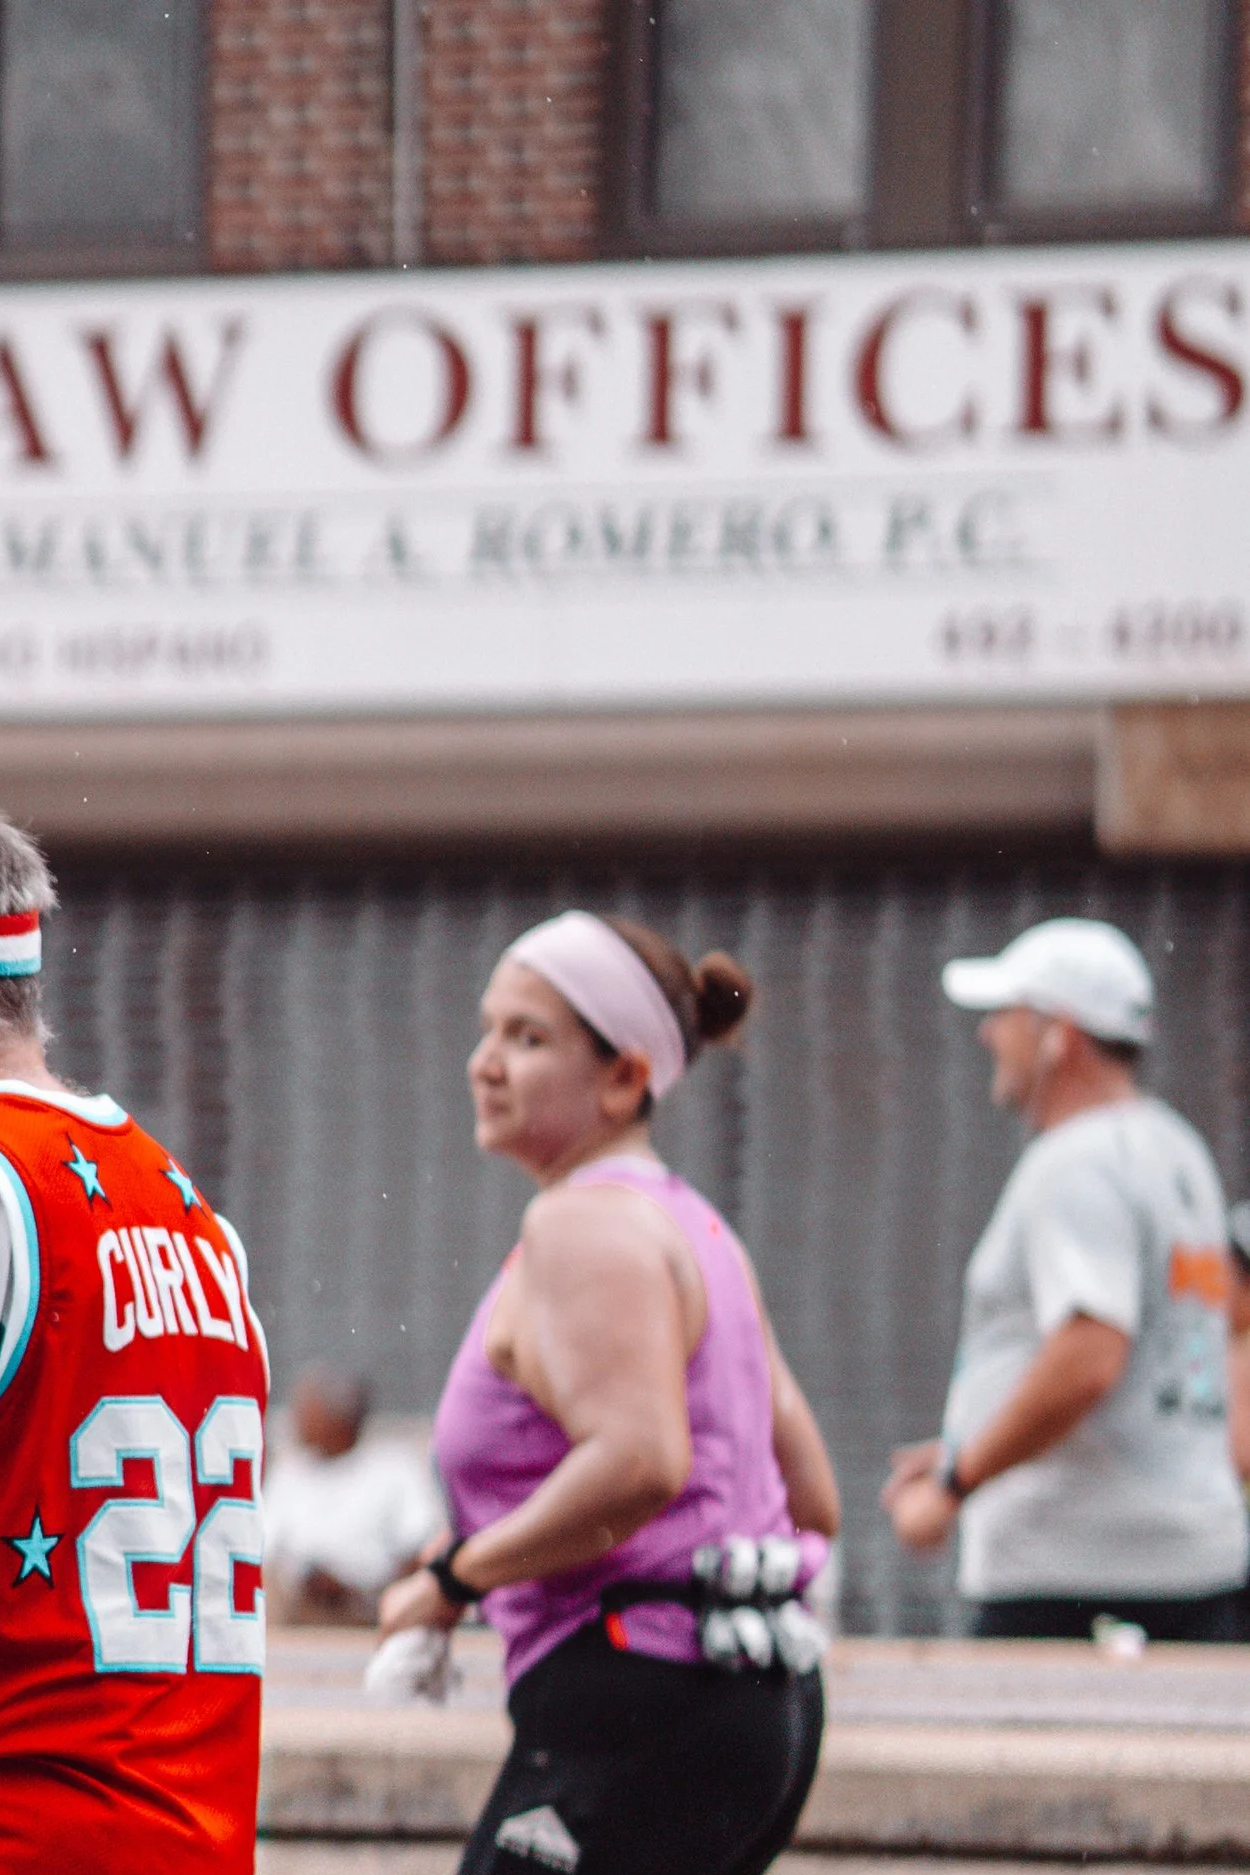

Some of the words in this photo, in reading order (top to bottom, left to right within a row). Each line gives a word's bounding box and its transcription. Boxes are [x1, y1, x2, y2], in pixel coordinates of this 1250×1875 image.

[320, 272, 1246, 470] OFFICES
[97, 1225, 249, 1353] CURLY
[69, 1394, 266, 1677] 22
